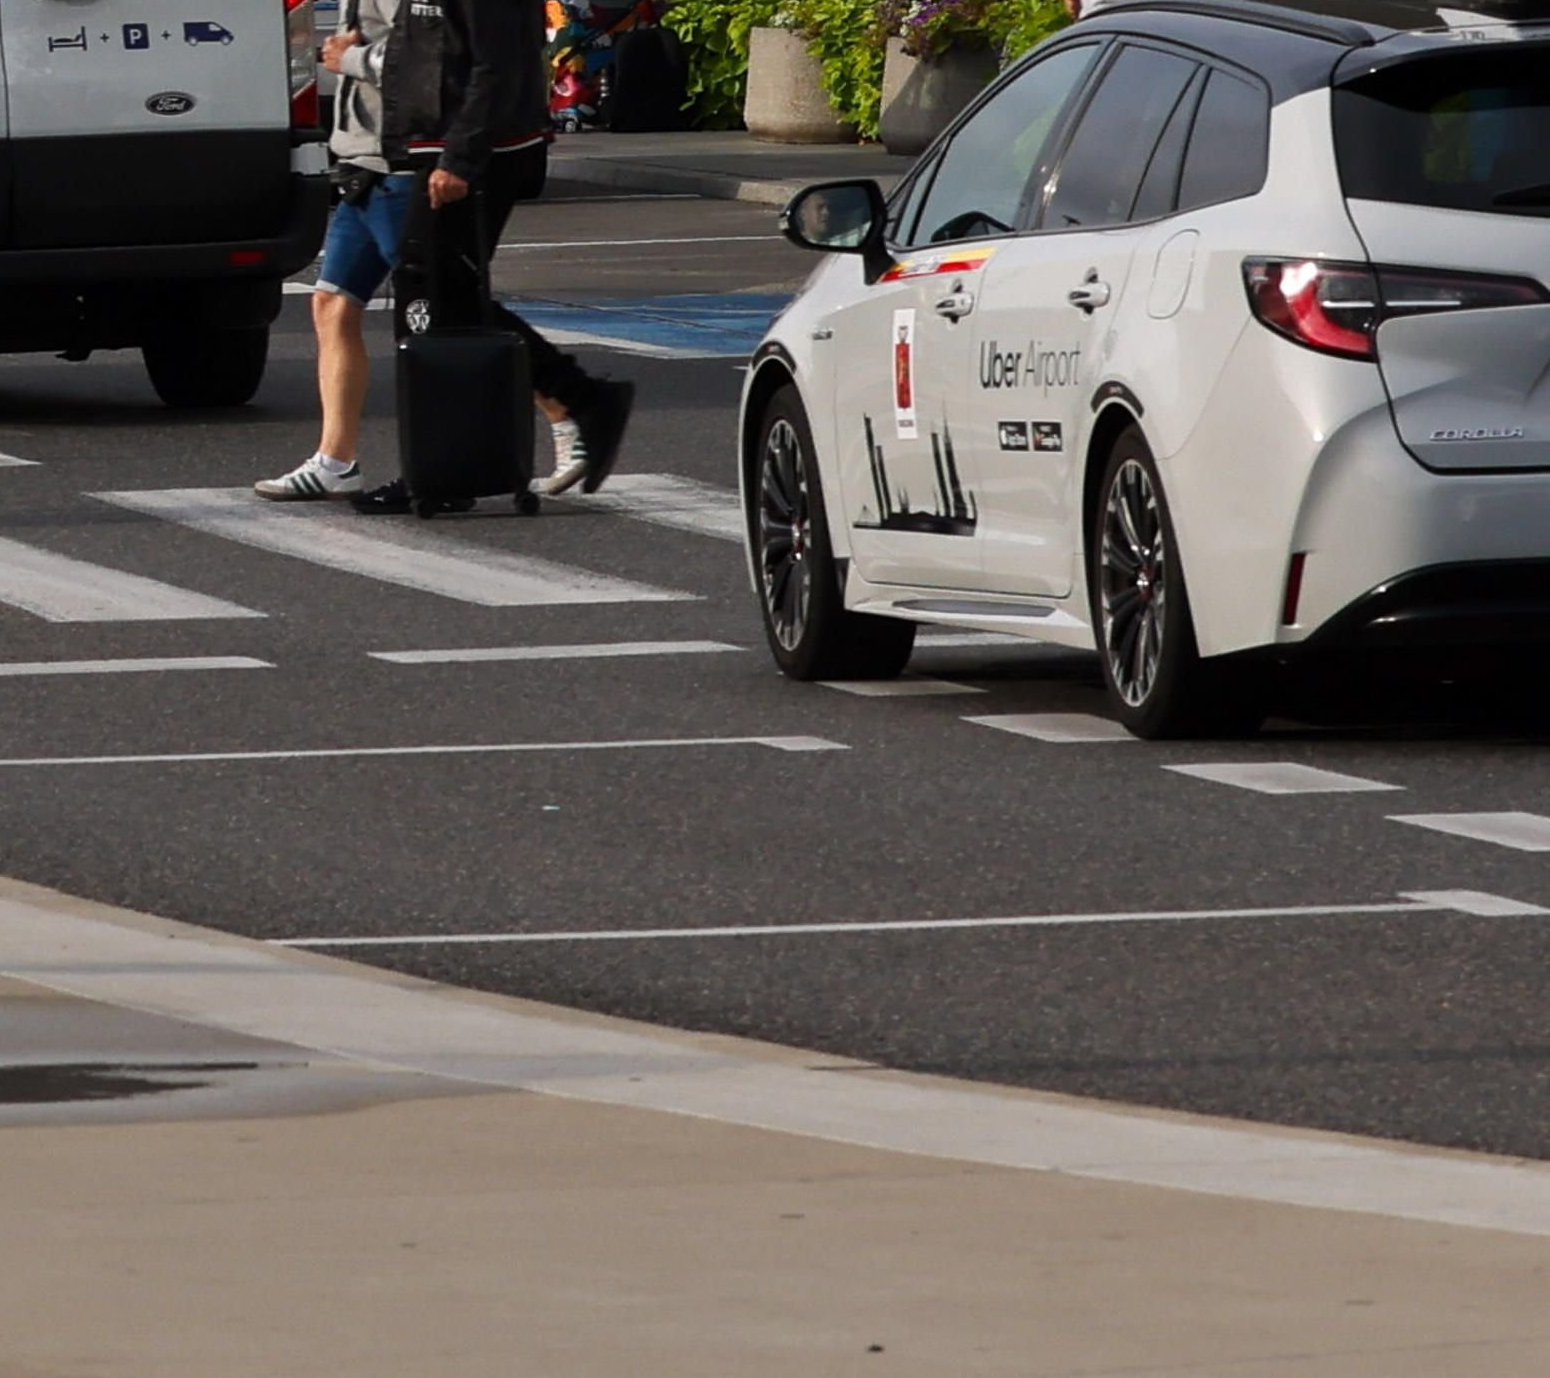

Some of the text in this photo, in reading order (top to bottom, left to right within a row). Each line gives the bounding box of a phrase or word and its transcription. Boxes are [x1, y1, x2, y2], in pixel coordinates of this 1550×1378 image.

[980, 339, 1081, 398] Uber Airport
[1430, 428, 1523, 441] COROLLA
